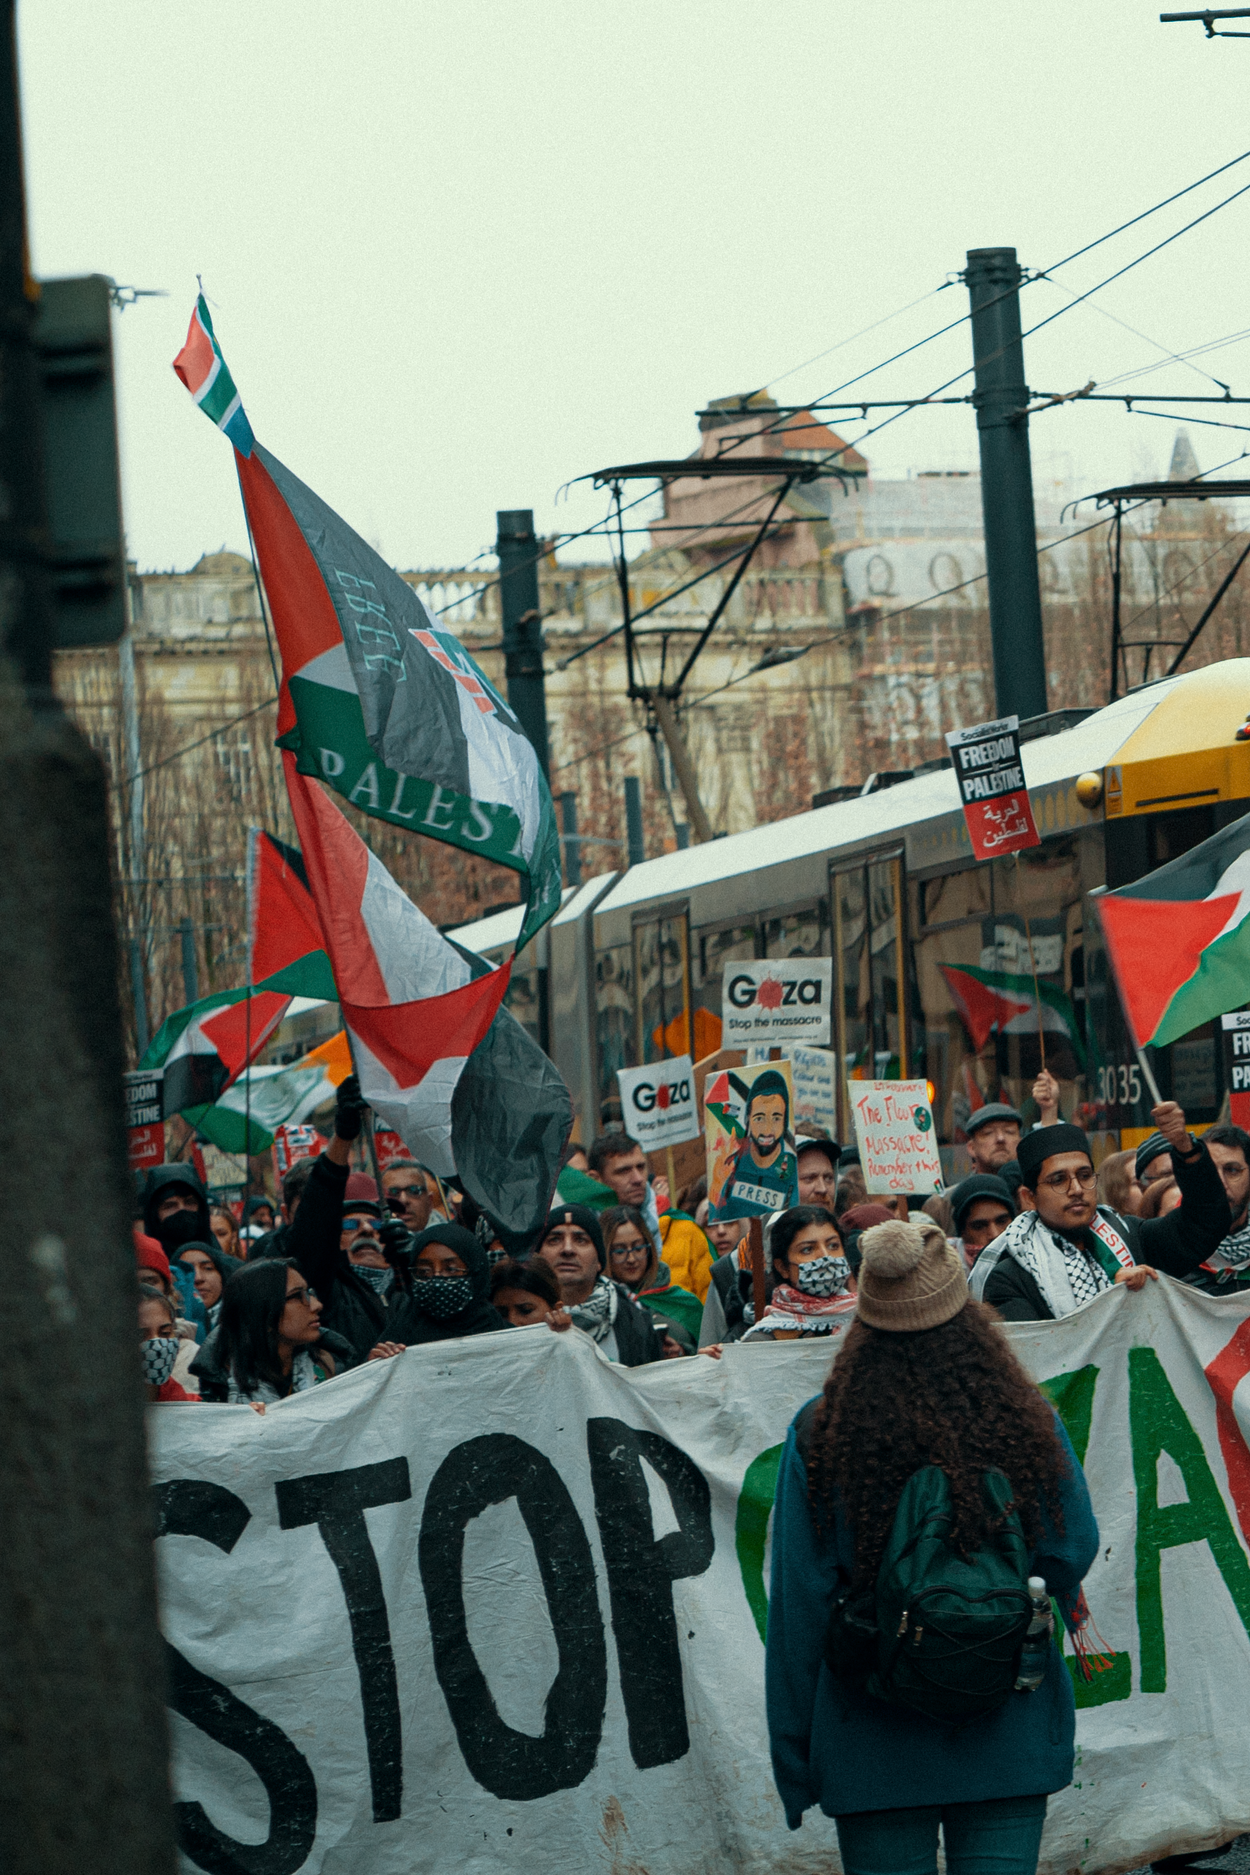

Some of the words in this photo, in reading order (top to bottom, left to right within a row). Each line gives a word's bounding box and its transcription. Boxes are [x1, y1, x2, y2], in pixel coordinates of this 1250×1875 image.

[959, 736, 1015, 770] FREEDOM
[962, 766, 1024, 800] PALESTINE
[728, 974, 822, 1009] Gza
[728, 1018, 752, 1031] Stop
[754, 1016, 770, 1027] the
[772, 1015, 823, 1027] massacre
[857, 1095, 882, 1127] The
[884, 1095, 920, 1126] Flour
[915, 1158, 940, 1175] this
[738, 1184, 779, 1208] PRESS
[888, 1176, 915, 1191] day
[154, 1416, 716, 1875] STOP
